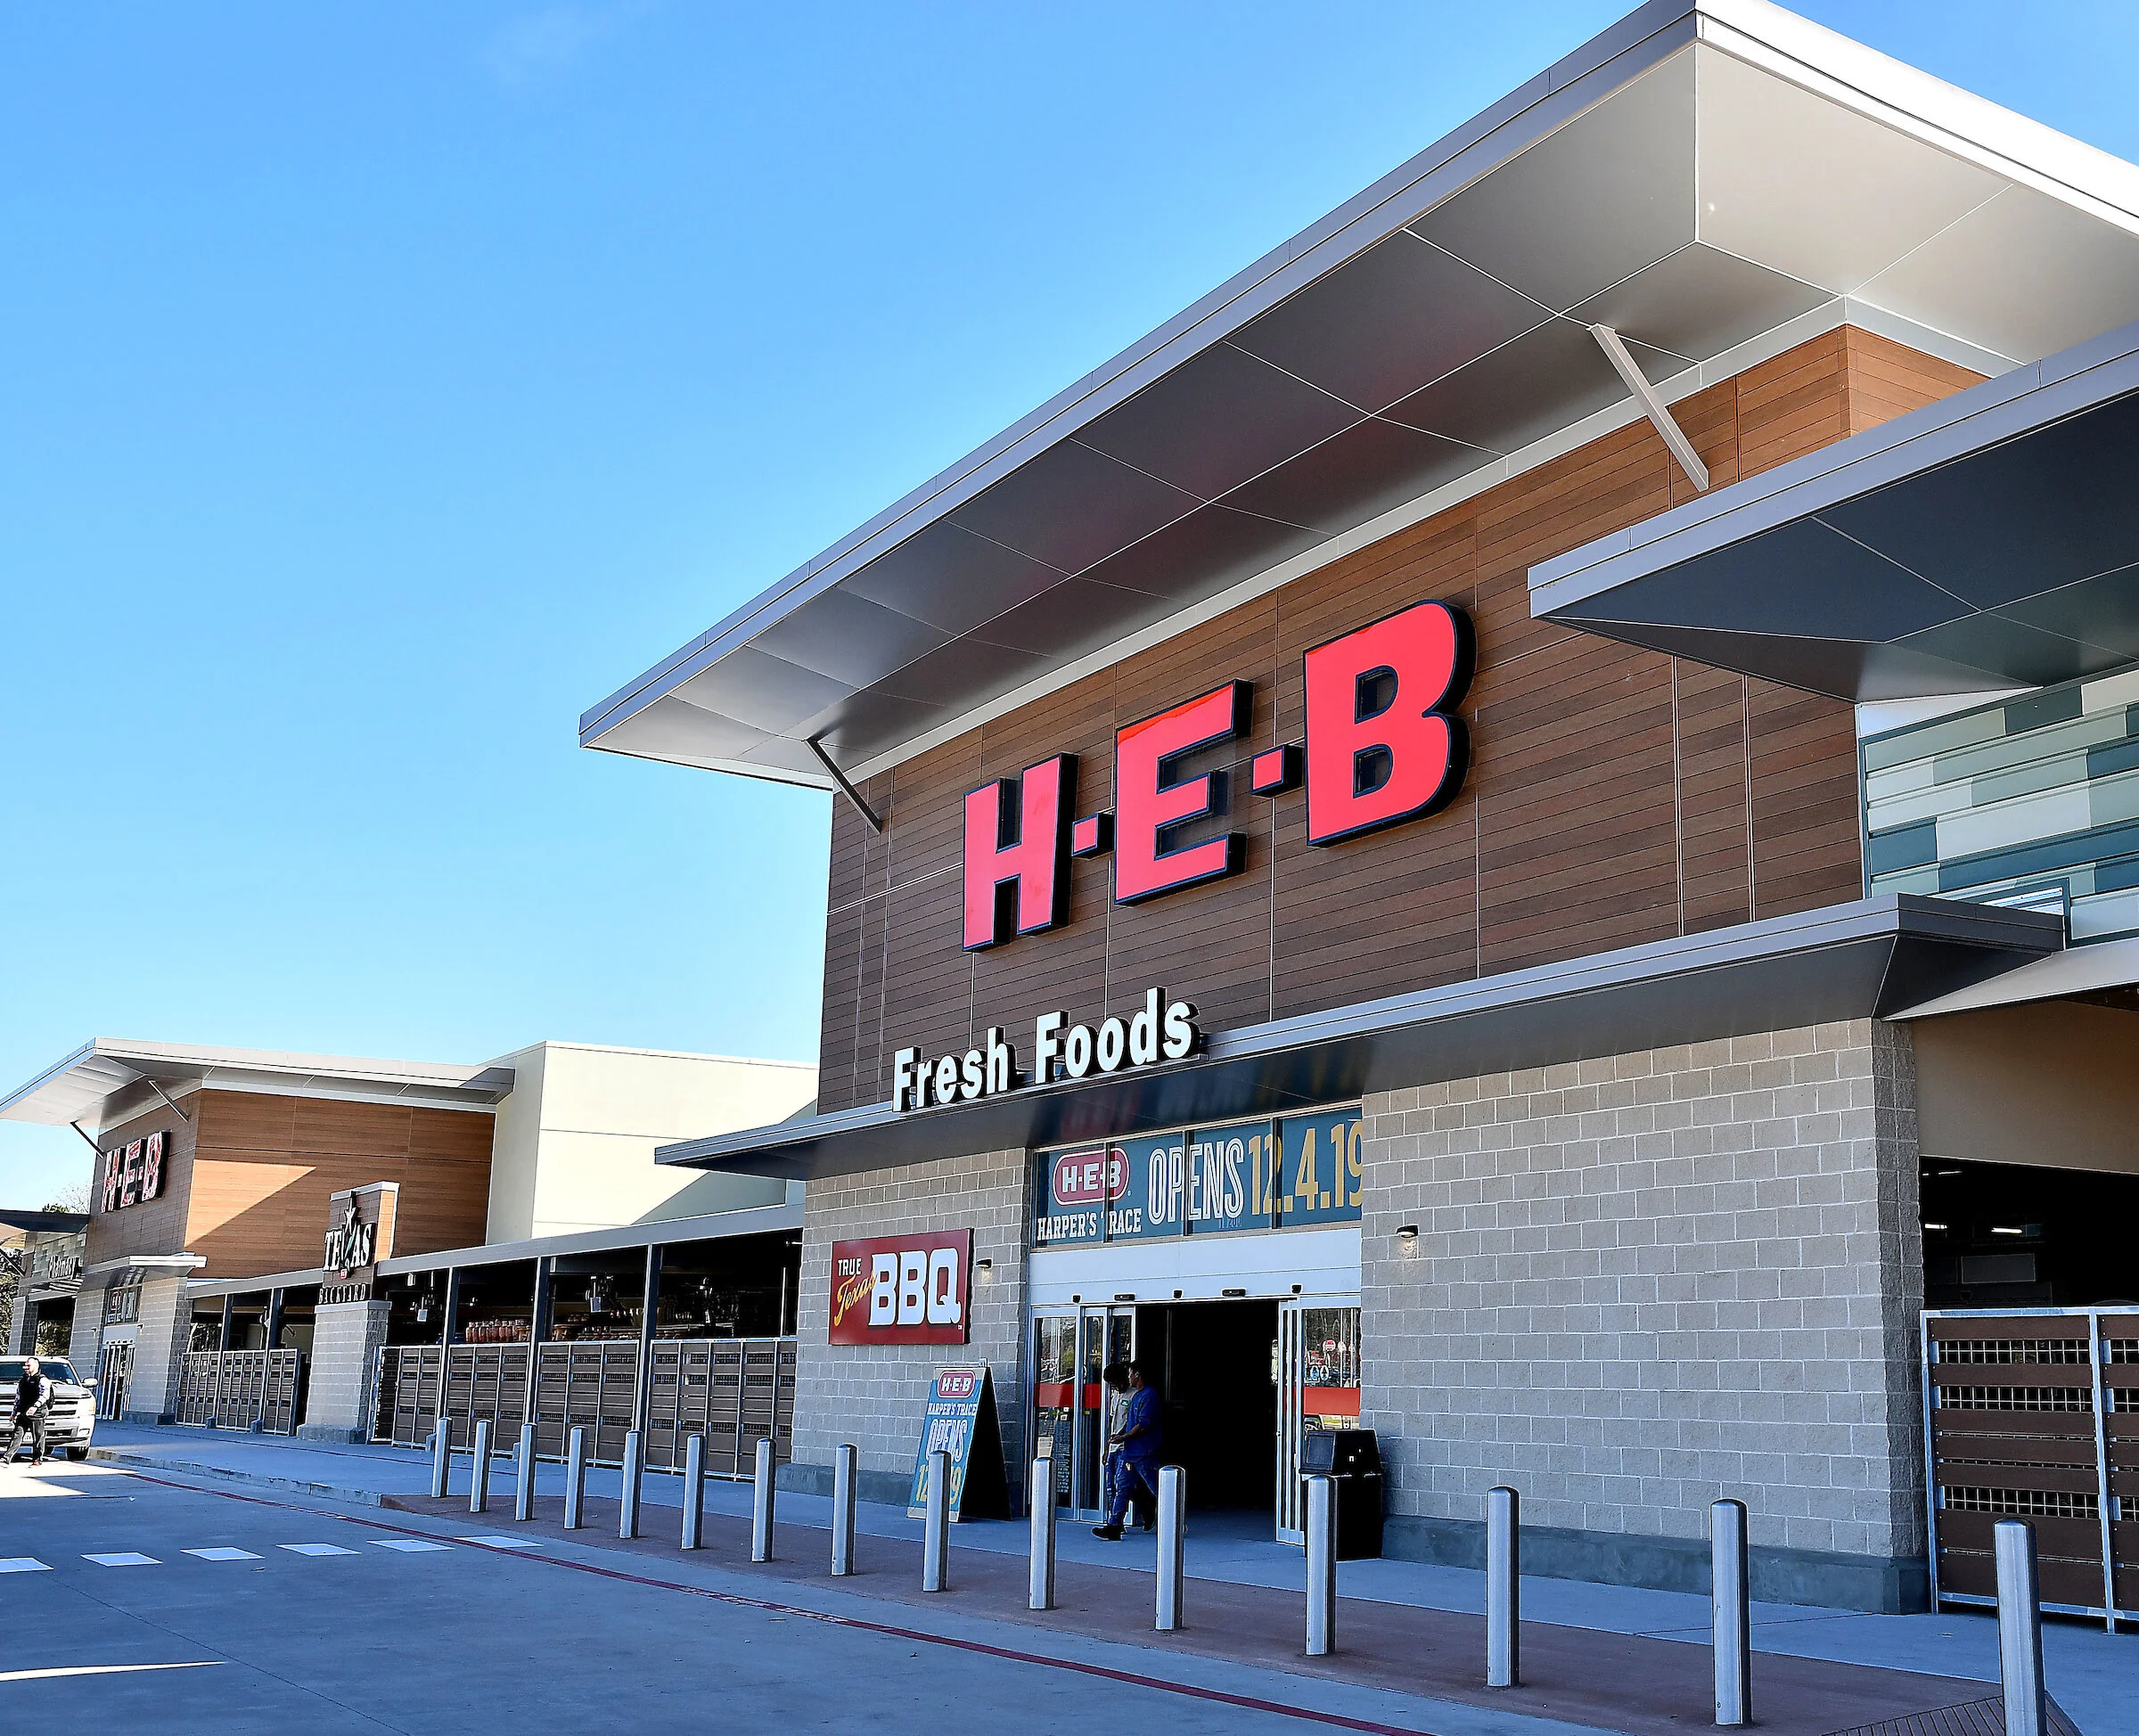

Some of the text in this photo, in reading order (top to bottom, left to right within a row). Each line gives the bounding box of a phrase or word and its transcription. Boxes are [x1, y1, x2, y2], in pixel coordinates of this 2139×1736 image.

[892, 986, 1198, 1113] Fresh Foods
[1148, 1137, 1244, 1225] OPENS
[1249, 1119, 1363, 1216] 12.4.19
[323, 1223, 373, 1272] TEXAS
[1037, 1208, 1142, 1241] HARPER'S RACE
[48, 1256, 77, 1281] Pharmacy
[838, 1257, 862, 1276] TRUE
[868, 1247, 962, 1326] BBQ
[318, 1283, 366, 1304] BACKYARD
[833, 1269, 878, 1327] Texas
[927, 1402, 978, 1416] HARPER'S TRACE
[925, 1418, 968, 1462] OPENS
